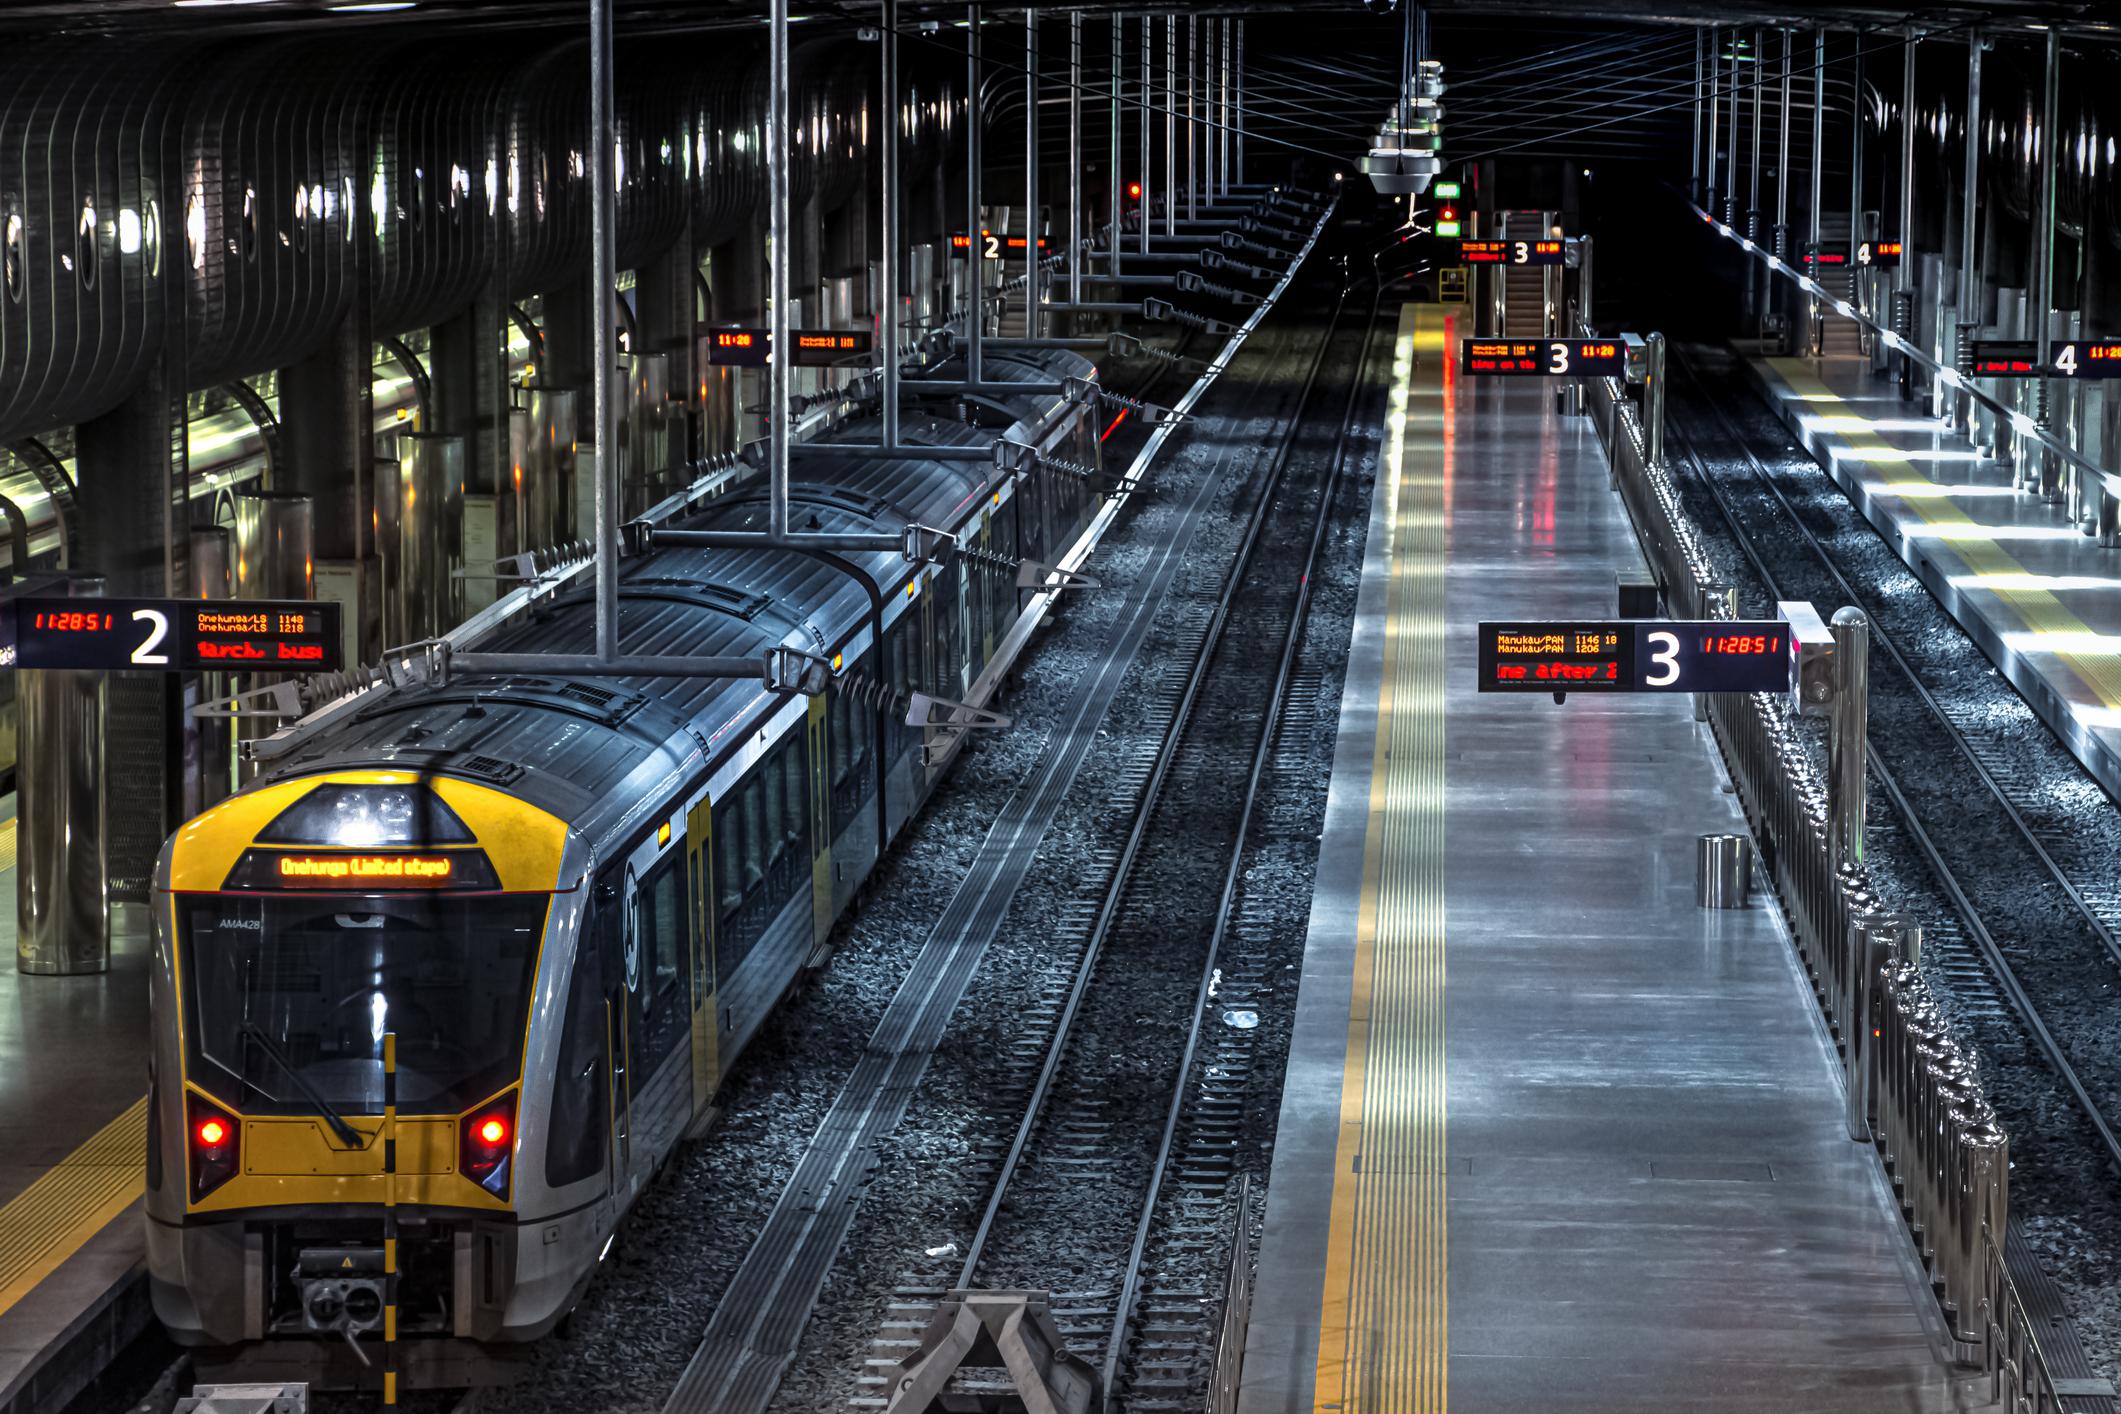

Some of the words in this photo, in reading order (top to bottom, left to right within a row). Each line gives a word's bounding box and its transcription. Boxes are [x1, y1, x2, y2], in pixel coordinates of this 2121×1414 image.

[984, 237, 999, 258] 2
[1514, 241, 1528, 264] 3
[1858, 243, 1871, 265] 4
[1549, 343, 1569, 374] 3
[2055, 345, 2077, 375] 4
[36, 613, 112, 630] 11:28:51
[198, 614, 267, 623] Onehunga/LS
[131, 609, 168, 664] 2
[198, 623, 267, 632] Onehunga/LS
[279, 624, 304, 633] 1218
[1498, 635, 1564, 645] Manukau/PAN
[1575, 635, 1600, 645] 1146
[1605, 635, 1617, 645] 18
[1498, 645, 1564, 653] Manukau/PAN
[1575, 645, 1600, 653] 1206
[1705, 636, 1779, 654] 11:28:51
[1646, 631, 1680, 686] 3
[1536, 662, 1598, 679] after
[281, 858, 348, 877] Onehunga
[219, 919, 260, 930] AMA428
